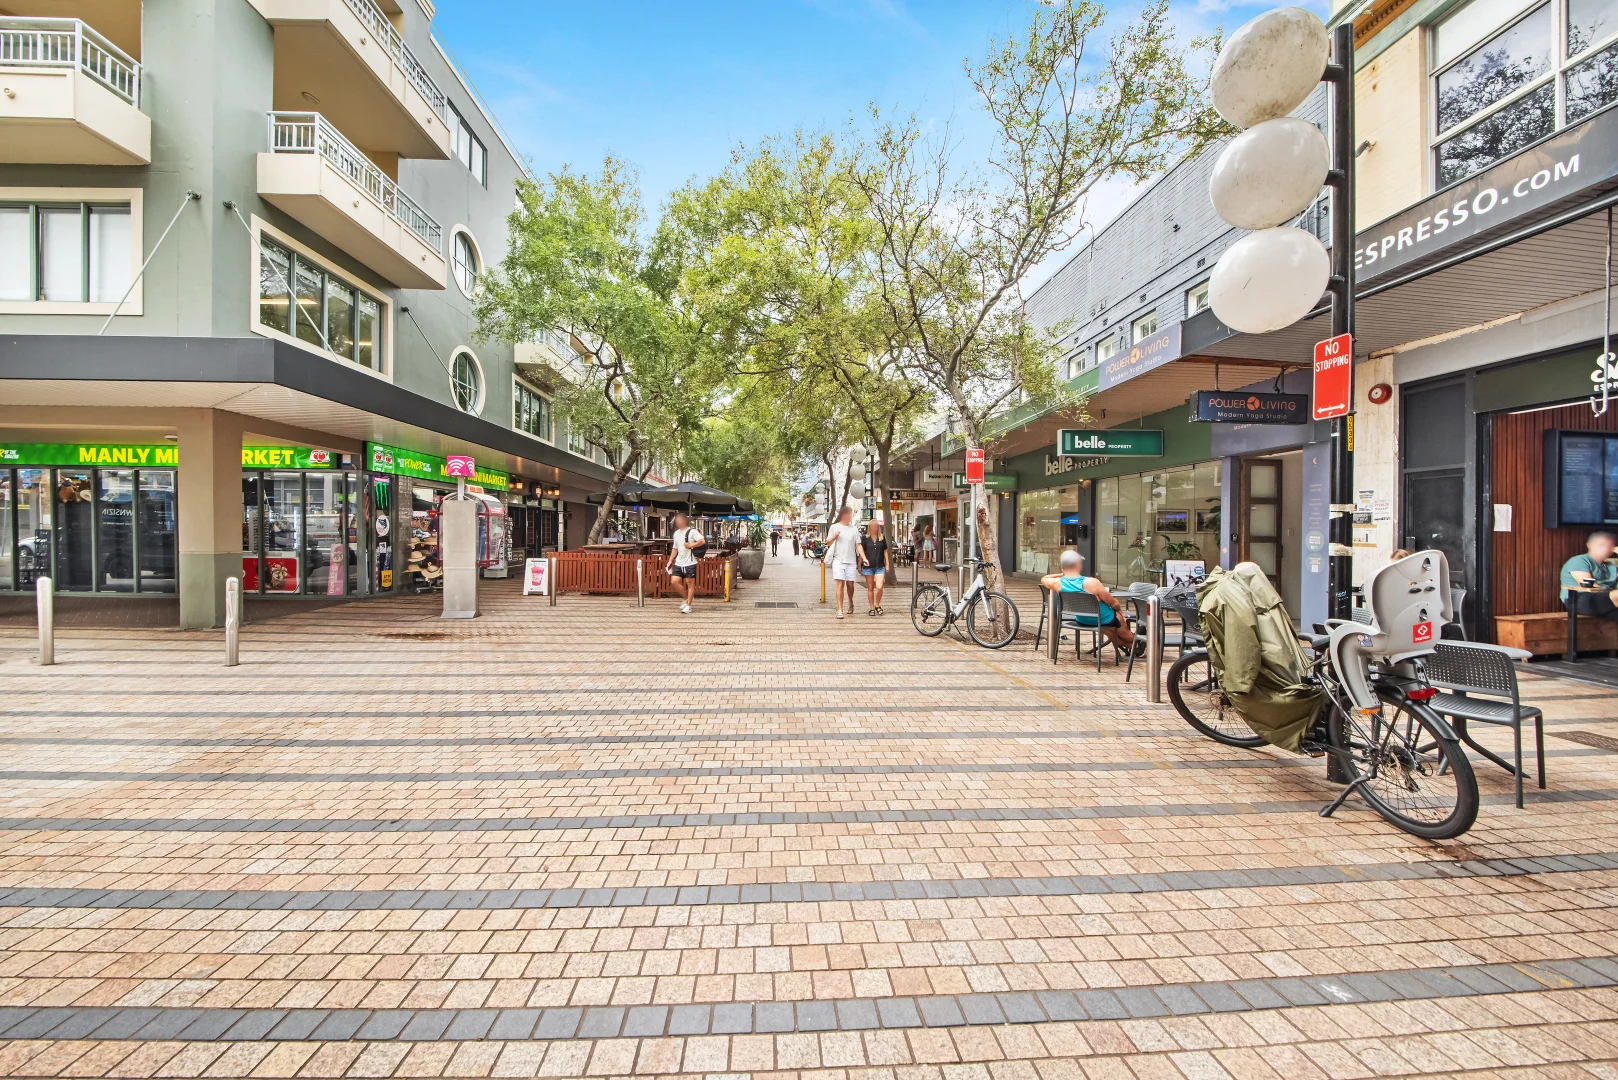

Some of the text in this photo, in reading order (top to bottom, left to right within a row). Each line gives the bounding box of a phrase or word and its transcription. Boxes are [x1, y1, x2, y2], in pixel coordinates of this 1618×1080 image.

[1105, 336, 1170, 375] POWER LIVING
[1325, 342, 1339, 356] NO
[1316, 354, 1349, 372] STOPPING
[1209, 398, 1296, 411] POWER LIVING
[1075, 435, 1106, 449] belle
[79, 447, 151, 463] MANLY
[1045, 454, 1109, 476] belle PROPERTY
[482, 472, 507, 487] MARKET
